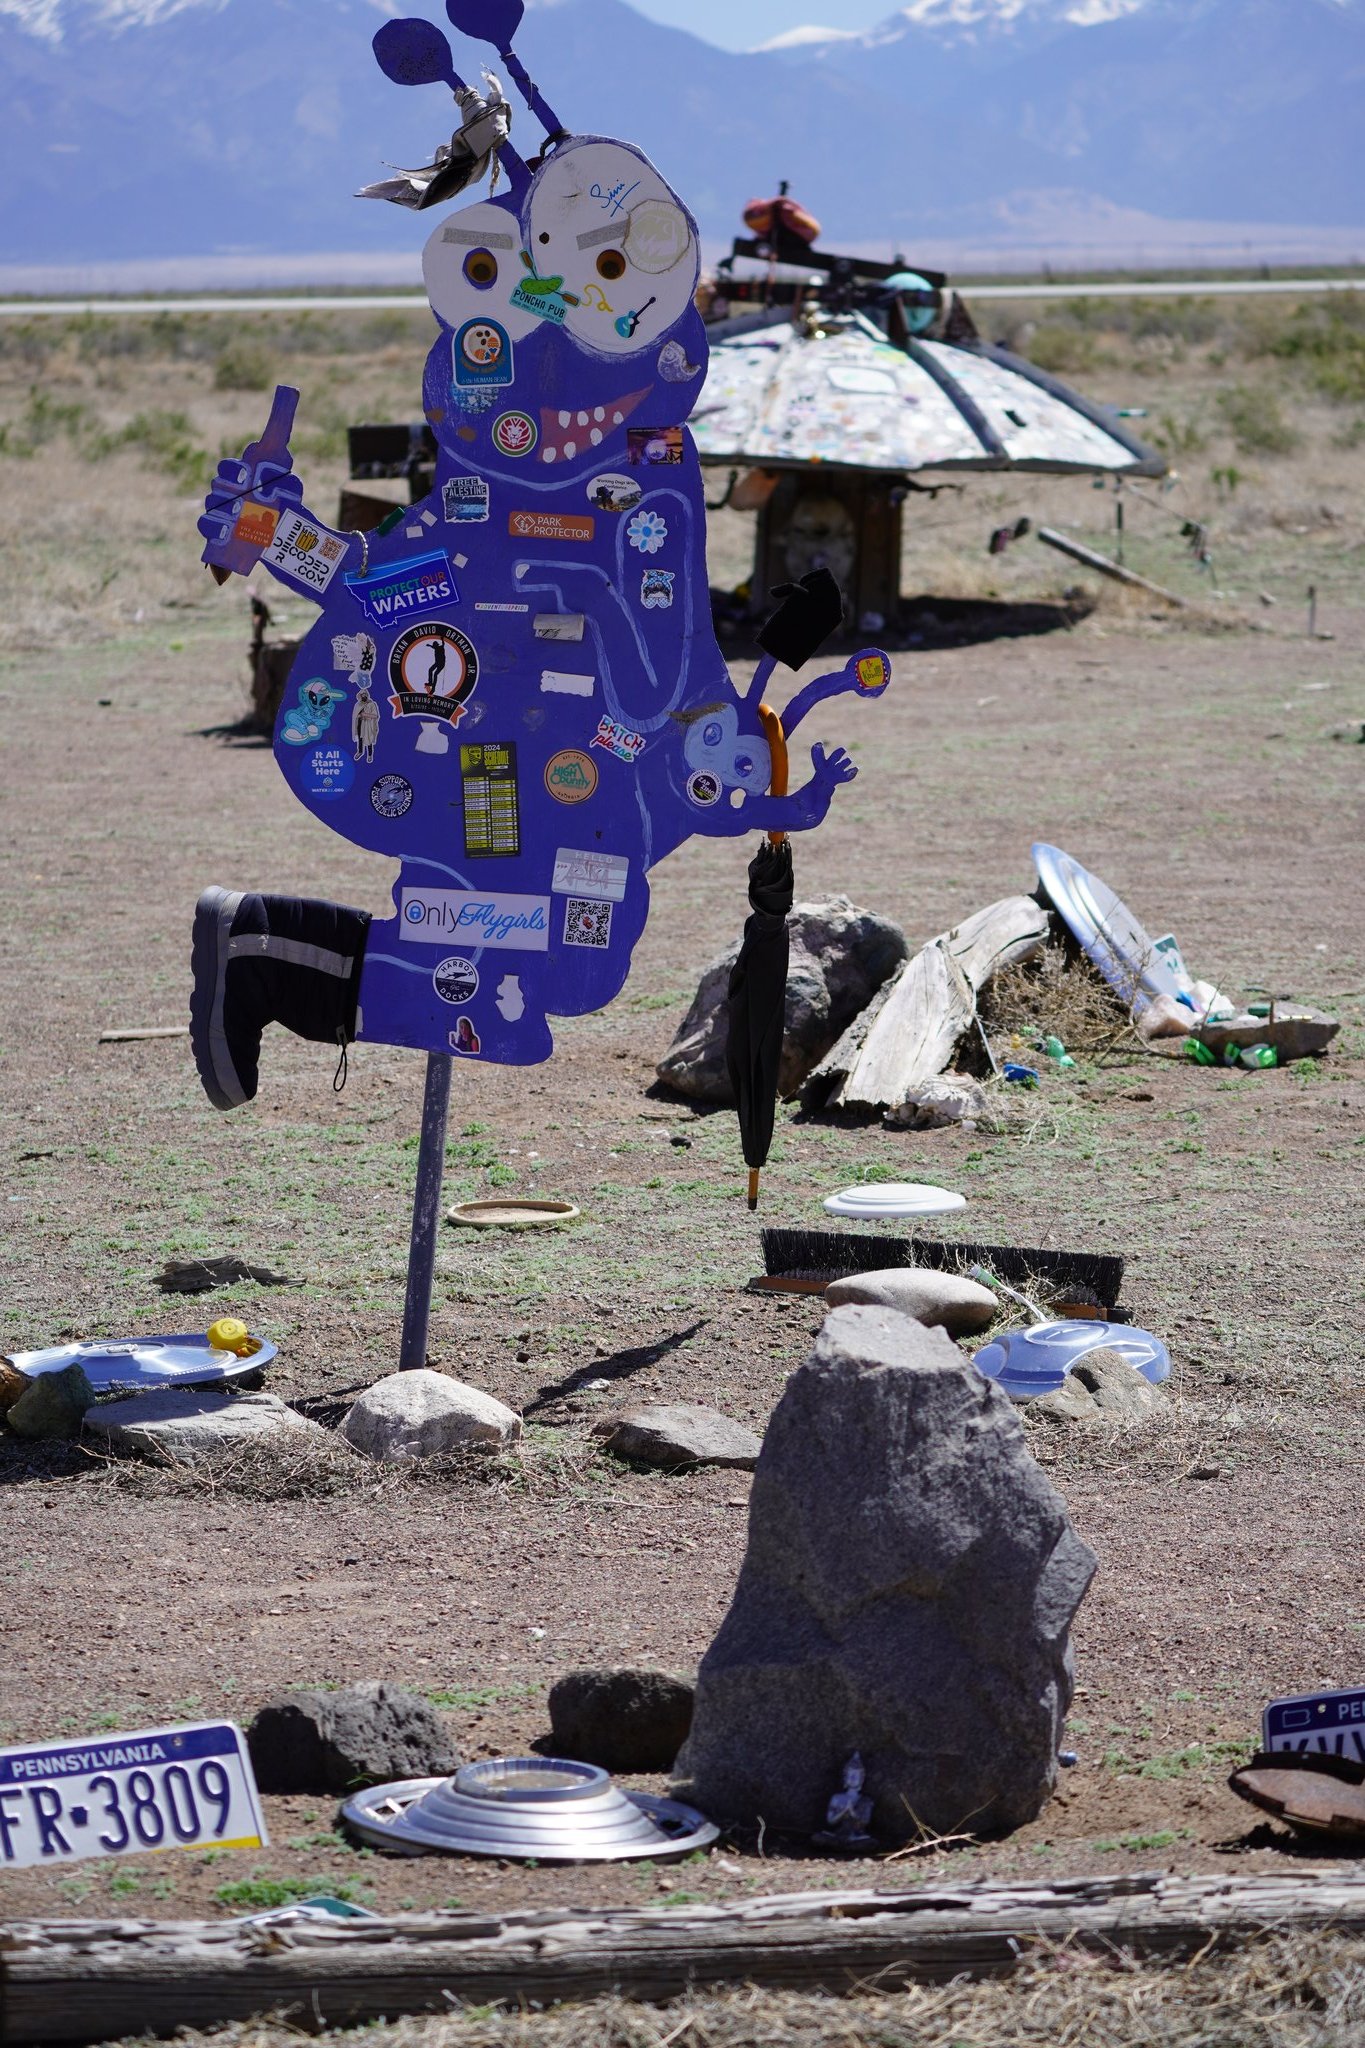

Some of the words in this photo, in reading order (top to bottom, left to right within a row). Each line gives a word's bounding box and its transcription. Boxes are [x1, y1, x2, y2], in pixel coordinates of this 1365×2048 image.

[513, 289, 546, 310] PONCHA
[547, 303, 565, 318] PUB
[451, 479, 478, 487] FREE
[444, 485, 487, 497] PALESTINE
[537, 516, 562, 526] PARK
[534, 526, 590, 539] PROTECTOR
[372, 581, 451, 615] WATERS
[392, 639, 409, 664] BRYAN
[414, 626, 437, 638] DAVID
[446, 629, 471, 655] ORTMAN
[432, 697, 455, 709] MEMORY
[599, 717, 644, 752] BATCH
[591, 735, 633, 760] please
[315, 751, 323, 759] It
[326, 750, 340, 759] All
[311, 759, 344, 767] Starts
[316, 767, 340, 775] Here
[554, 765, 576, 777] HIGH
[378, 775, 408, 788] SUPPORT
[550, 773, 590, 789] Country
[697, 776, 711, 786] ZAP
[700, 784, 715, 796] ZING
[575, 852, 613, 864] HELLO
[440, 960, 474, 976] HARBOR
[440, 987, 469, 1000] DOCKS
[11, 1742, 167, 1778] PENNSYLVANIA
